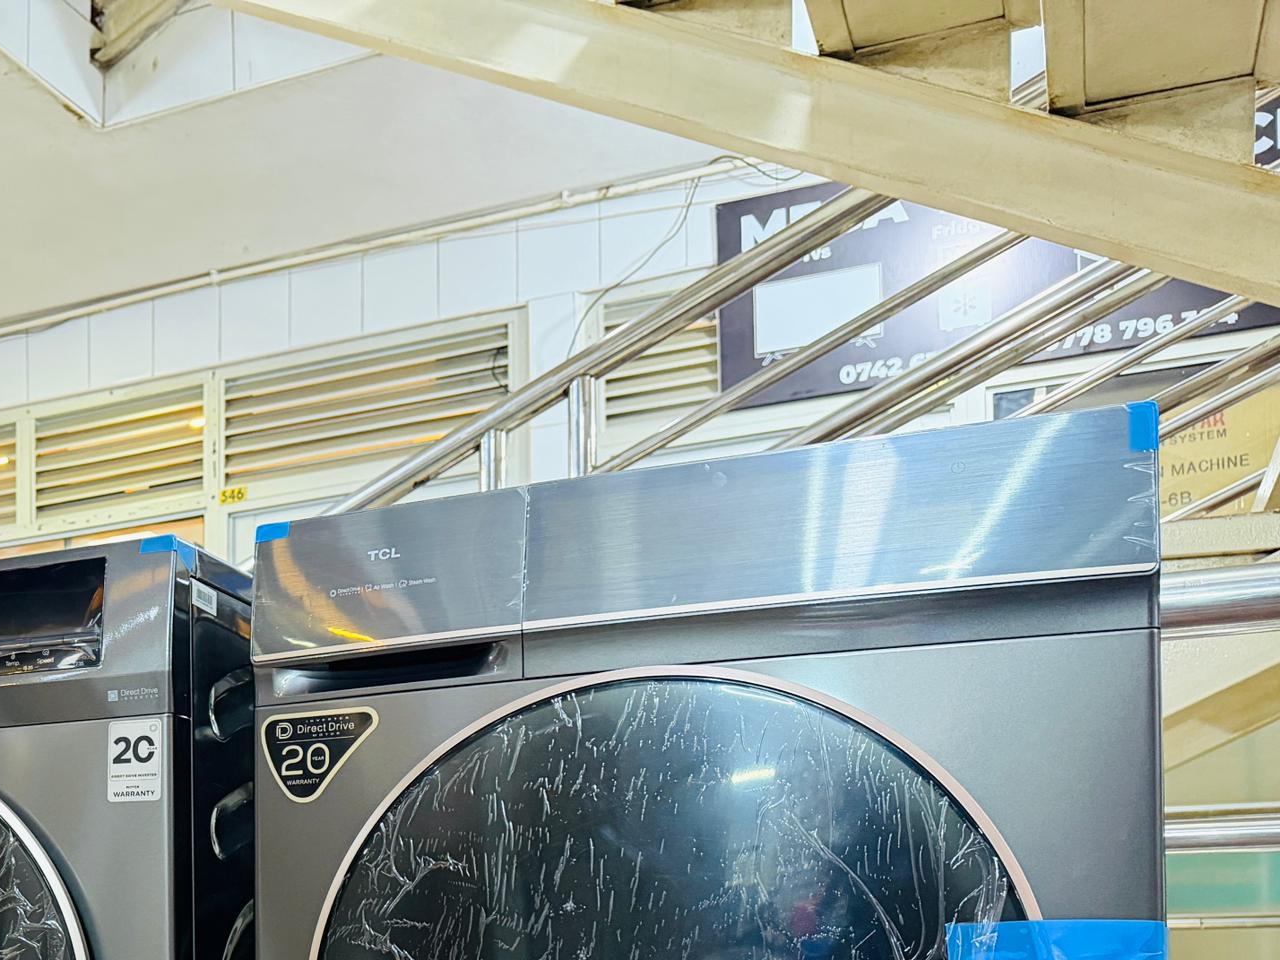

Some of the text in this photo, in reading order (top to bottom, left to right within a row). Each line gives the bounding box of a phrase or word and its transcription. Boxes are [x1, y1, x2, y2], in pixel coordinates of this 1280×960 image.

[1120, 314, 1174, 340] 796
[839, 356, 903, 385] 0742
[1169, 428, 1228, 446] SYSTEM
[1171, 453, 1251, 477] MACHINE
[367, 547, 401, 561] TCL
[120, 687, 159, 696] Direct Drive
[297, 721, 355, 734] Direct Drive
[281, 743, 330, 776] 20
[286, 778, 320, 786] WARRANTY
[113, 790, 156, 798] WARRANTY
